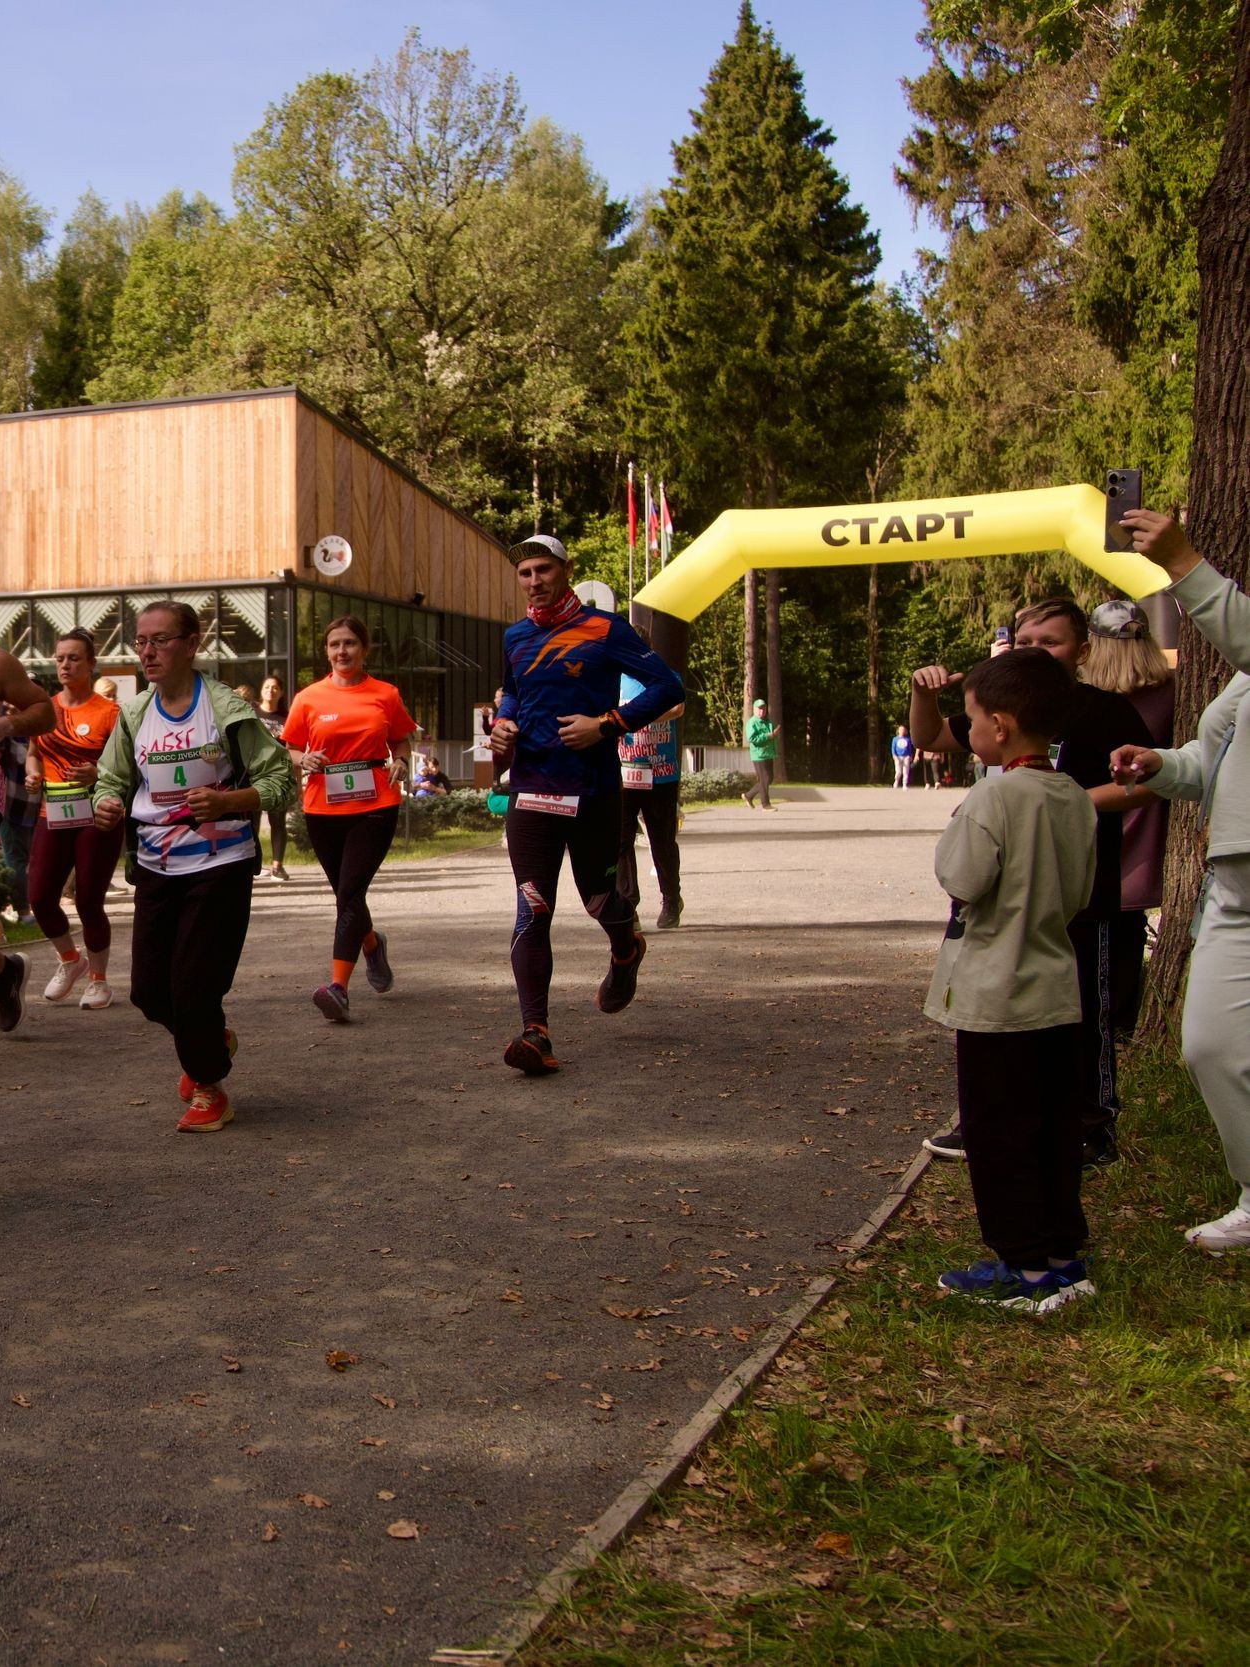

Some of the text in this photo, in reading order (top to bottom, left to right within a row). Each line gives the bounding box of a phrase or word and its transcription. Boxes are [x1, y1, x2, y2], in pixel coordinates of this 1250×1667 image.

[821, 510, 974, 547] СТАРТ
[152, 753, 177, 762] КРОСС
[174, 766, 187, 787] 4
[344, 774, 355, 791] 9
[626, 771, 643, 782] 118
[61, 804, 75, 818] 11
